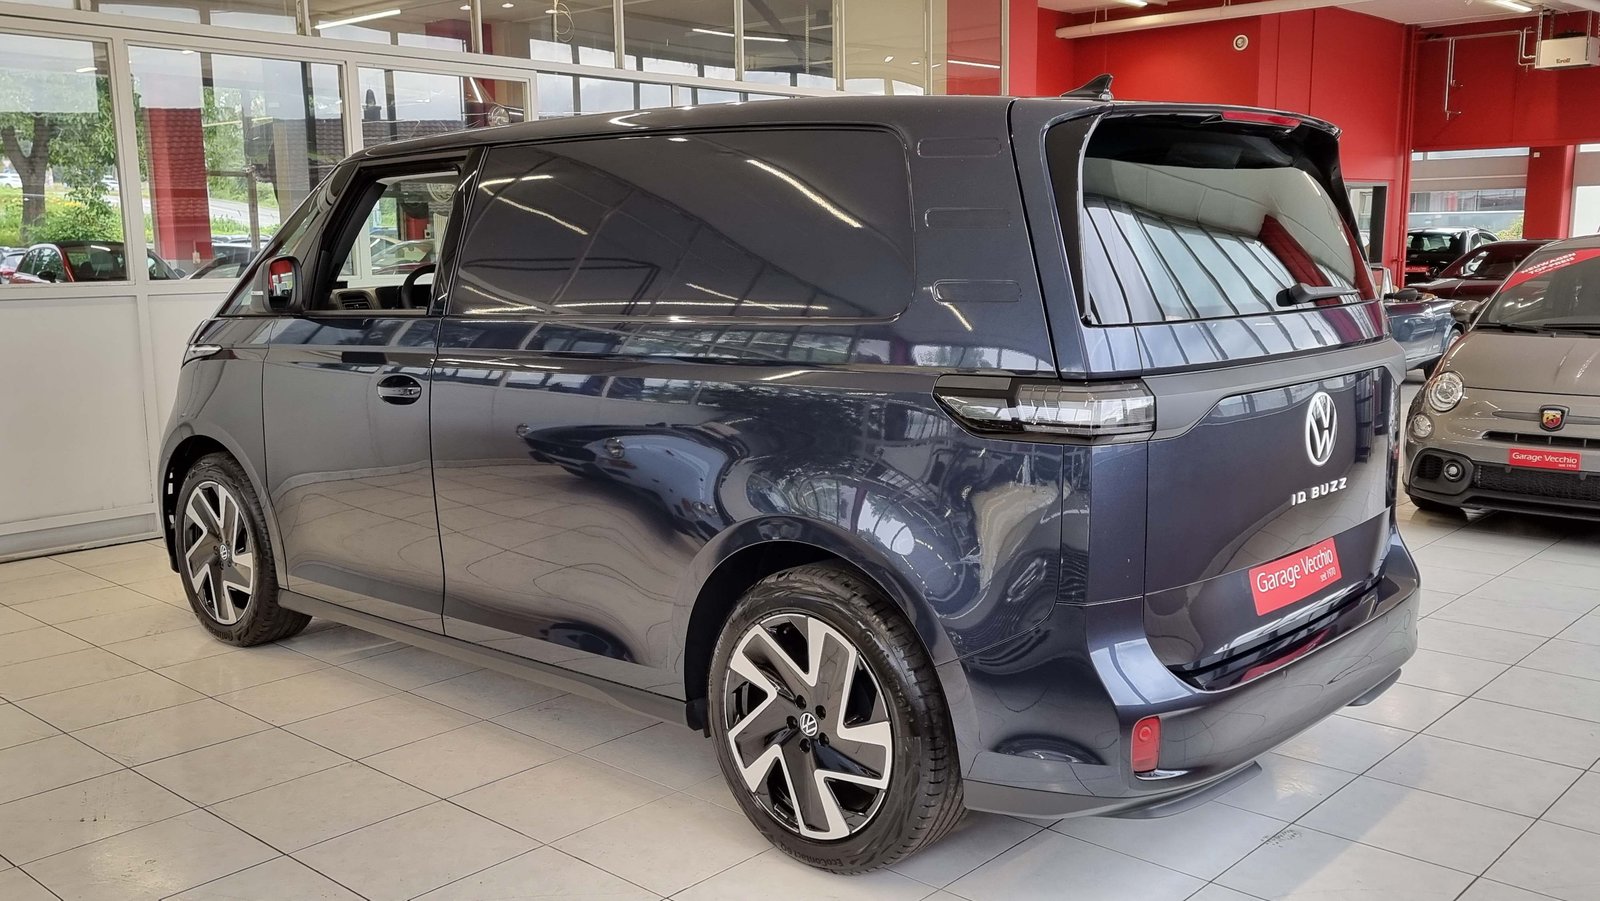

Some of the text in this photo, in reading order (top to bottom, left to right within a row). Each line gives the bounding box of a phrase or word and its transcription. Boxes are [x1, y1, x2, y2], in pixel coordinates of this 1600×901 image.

[1512, 452, 1578, 464] Garage Vecchio
[1311, 477, 1347, 499] BUZZ
[1256, 547, 1334, 593] Garage Vecchio
